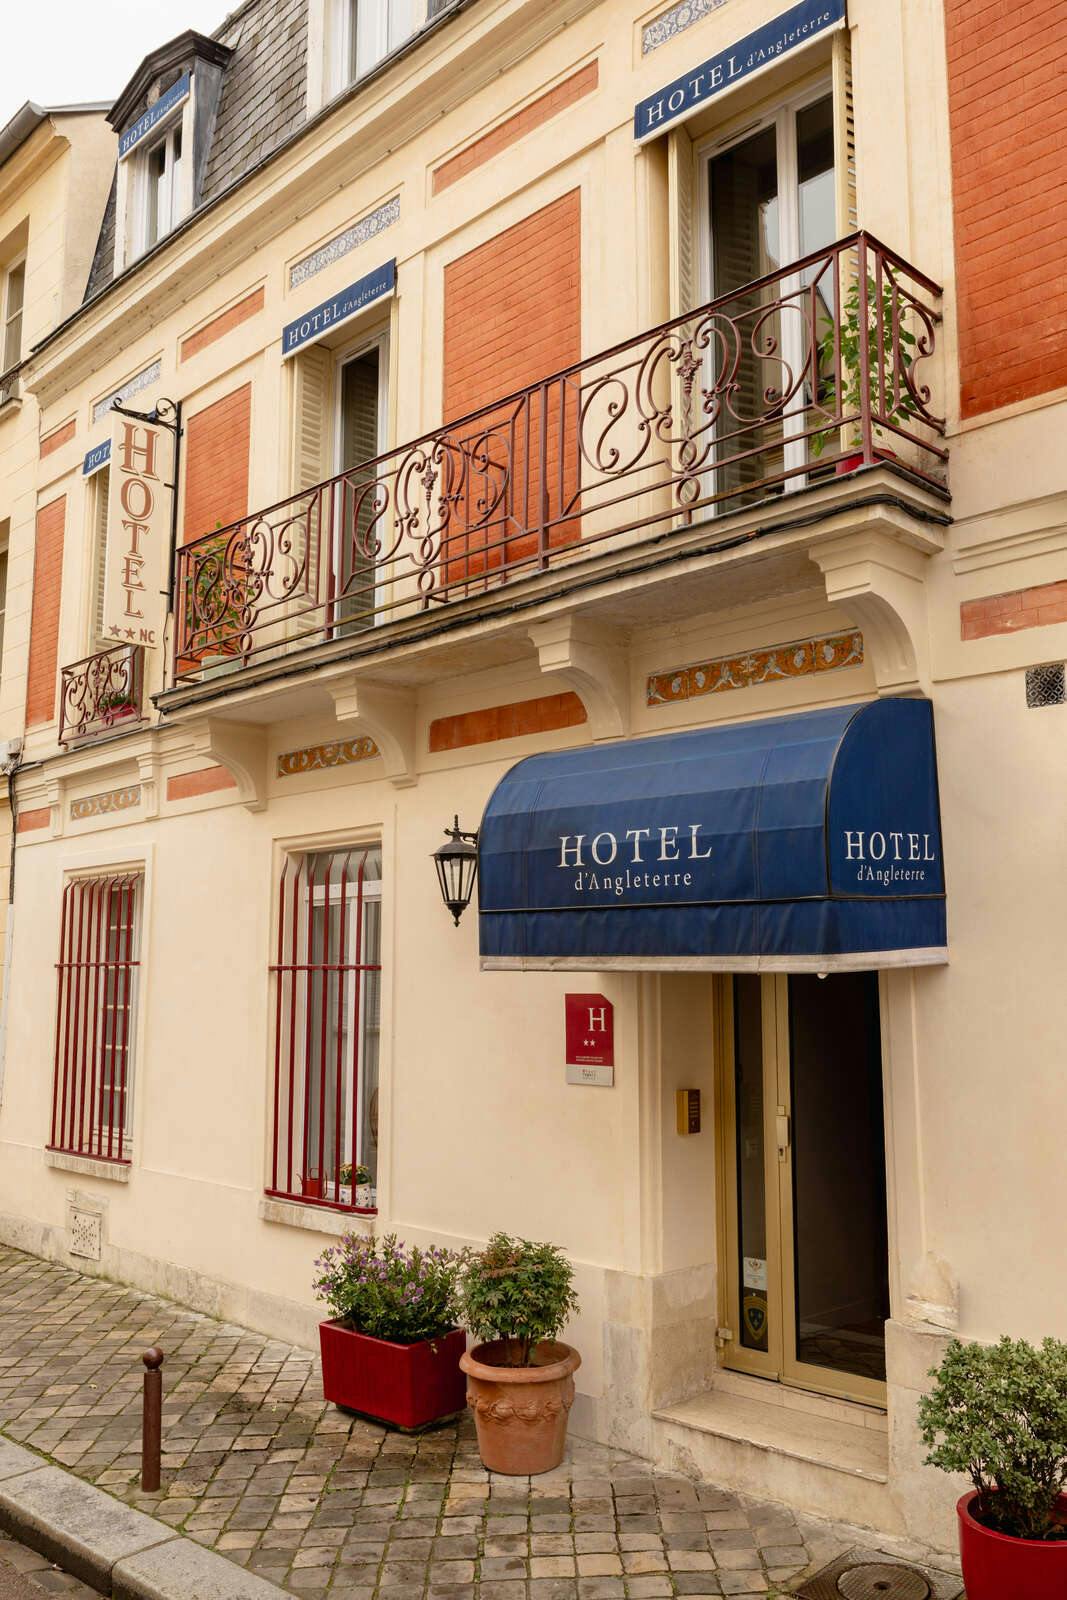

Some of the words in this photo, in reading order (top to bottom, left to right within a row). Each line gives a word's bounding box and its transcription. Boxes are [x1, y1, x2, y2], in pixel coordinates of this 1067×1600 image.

[646, 55, 743, 127] HOTEL
[746, 11, 830, 67] d'Angleterre
[122, 111, 156, 151] HOTEL
[288, 302, 341, 346] HOTEL
[342, 281, 387, 313] d'Angleterre
[87, 444, 111, 469] HOT
[119, 421, 160, 619] HOTEL
[139, 628, 155, 644] NC
[557, 824, 713, 868] HOTEL
[844, 831, 935, 861] HOTEL
[574, 869, 693, 896] d'Angleterre
[857, 864, 925, 886] d'Angleterre
[588, 1007, 607, 1032] H
